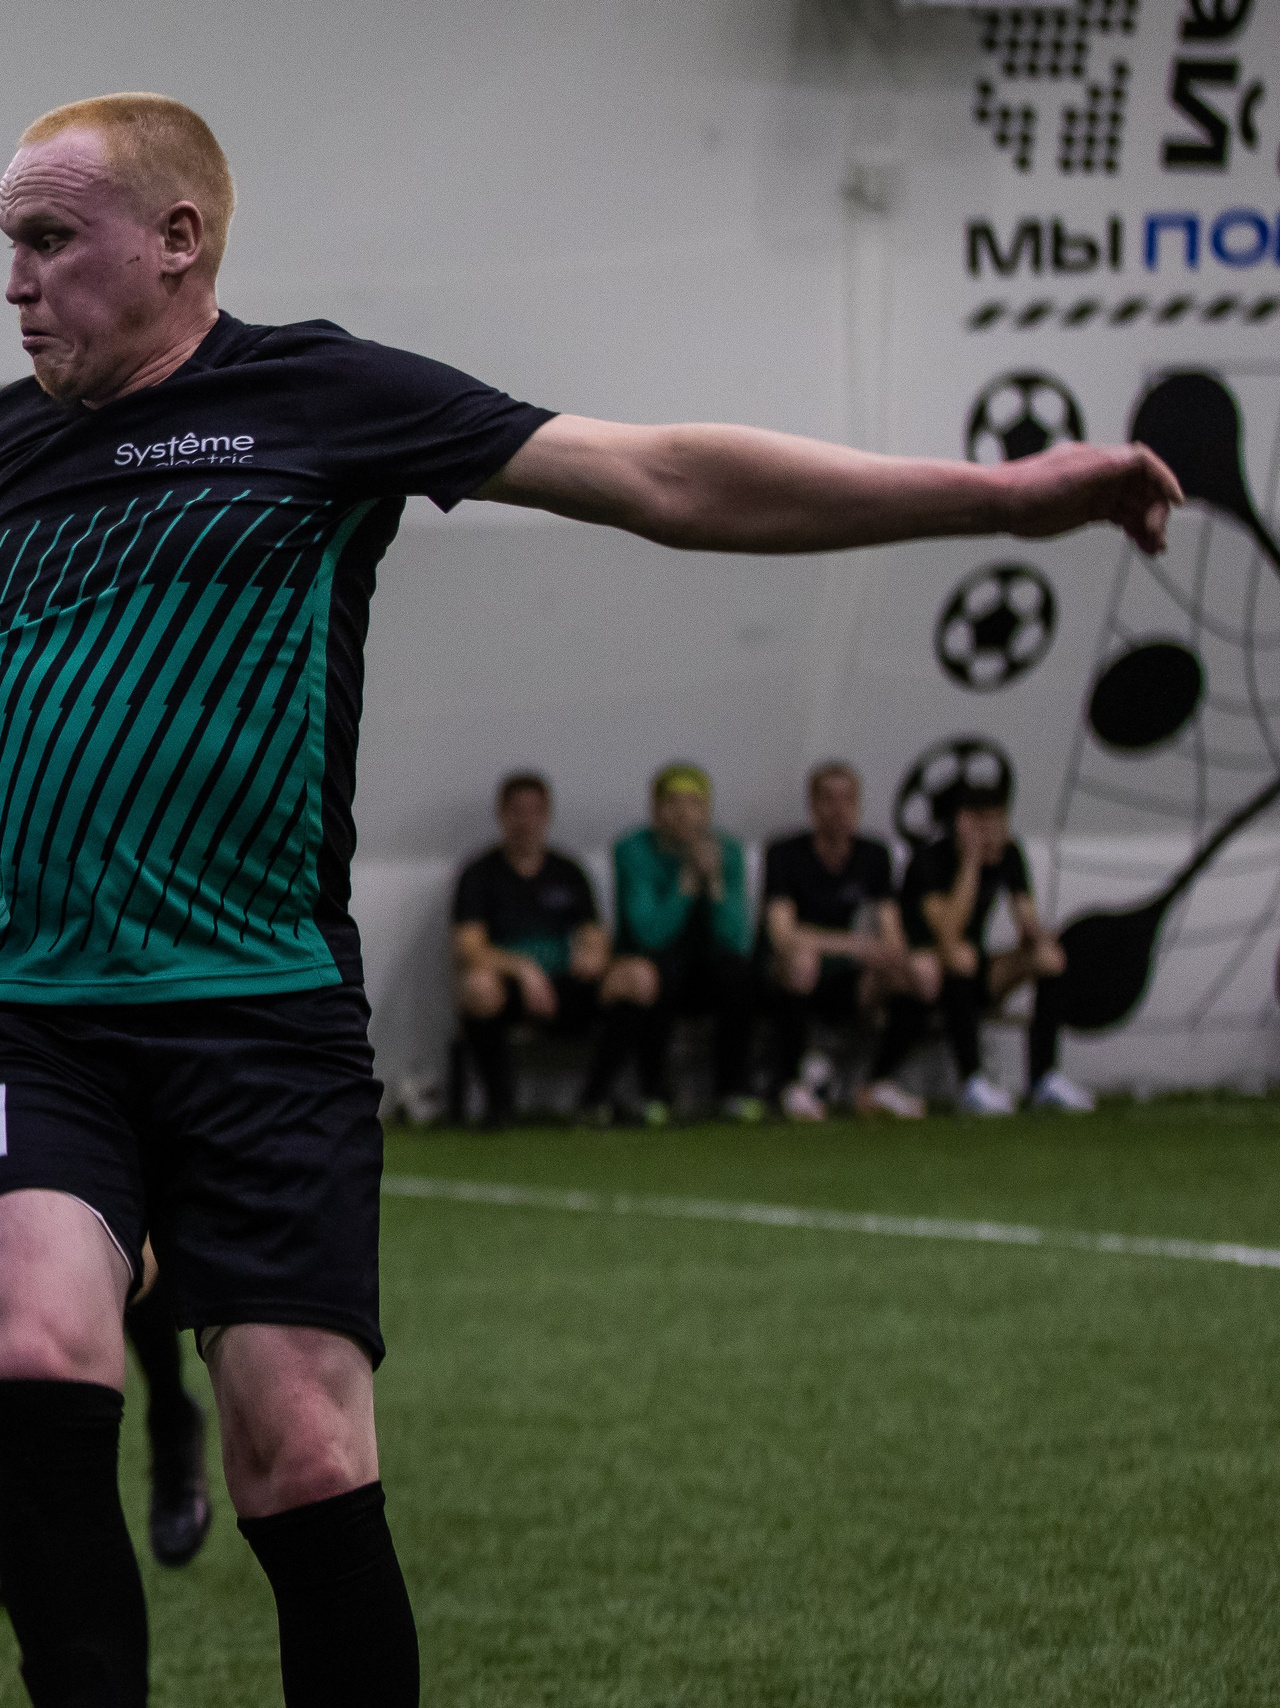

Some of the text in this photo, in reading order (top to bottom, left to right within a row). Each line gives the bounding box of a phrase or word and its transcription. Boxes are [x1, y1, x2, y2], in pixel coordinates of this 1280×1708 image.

[1144, 209, 1280, 270] ПО
[114, 432, 255, 467] Systême
[155, 453, 254, 466] ltric
